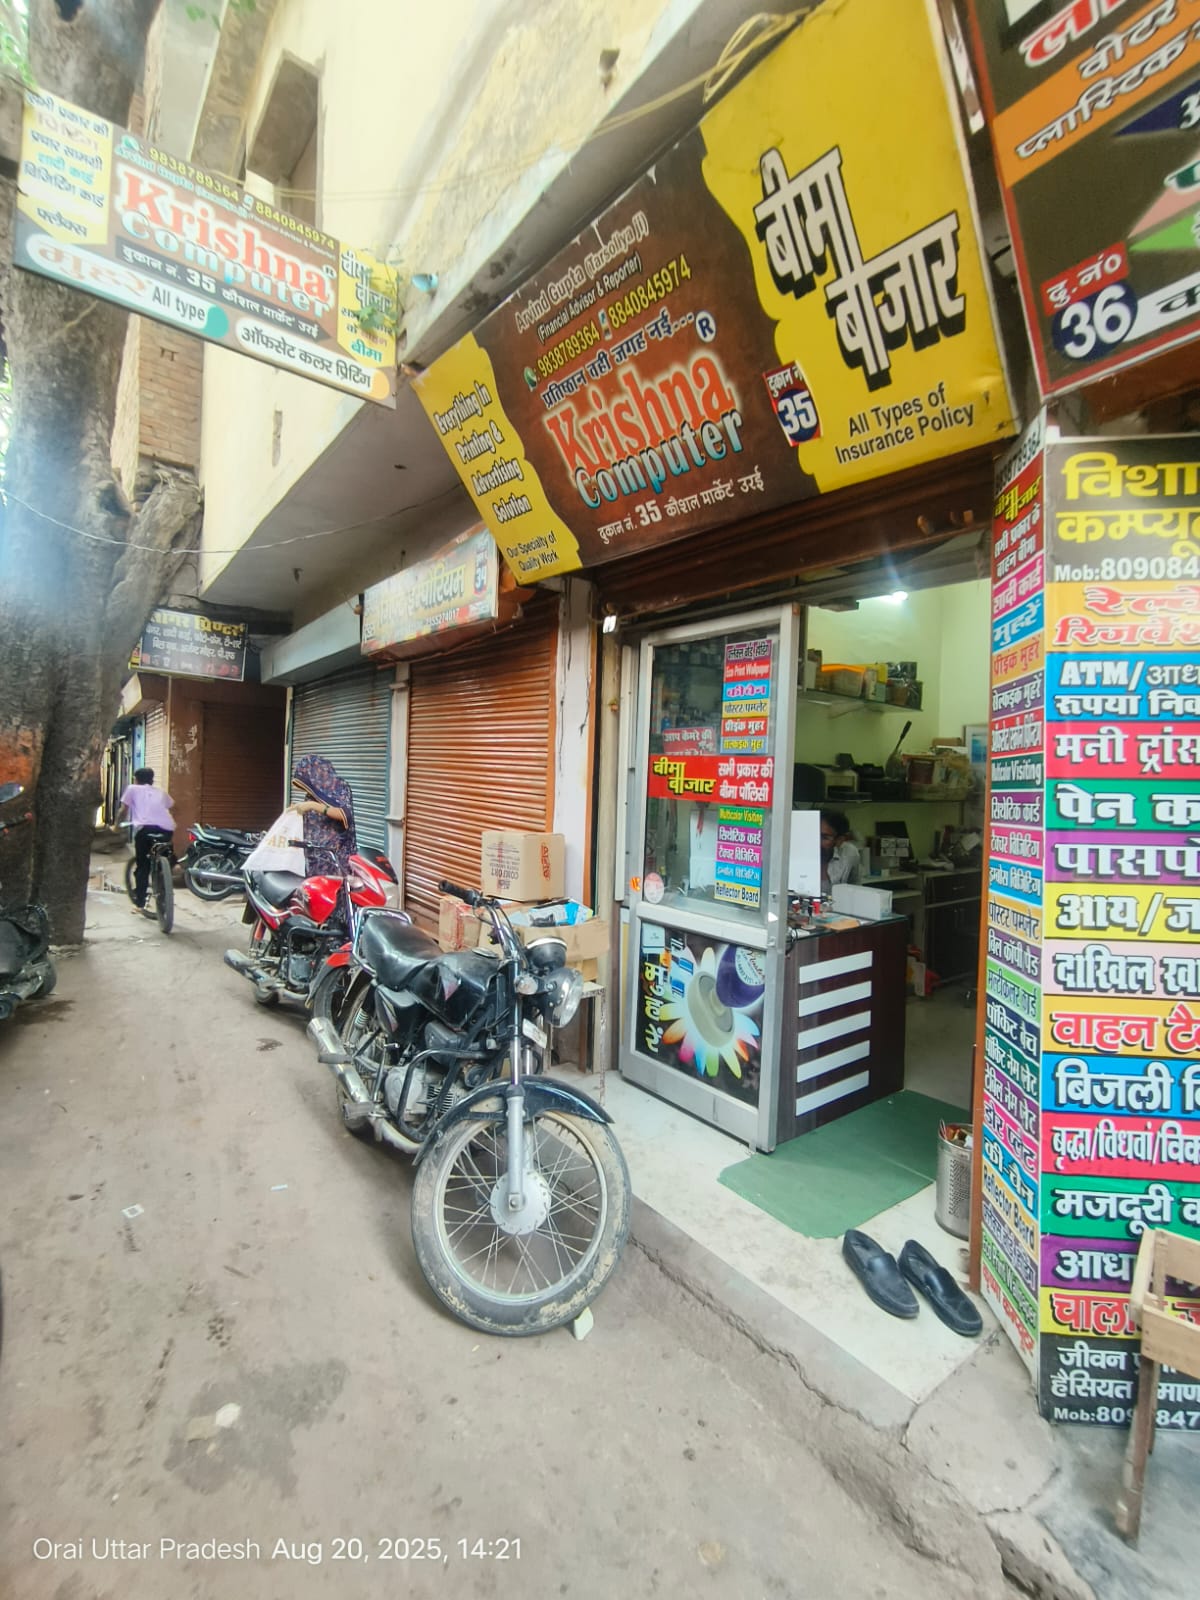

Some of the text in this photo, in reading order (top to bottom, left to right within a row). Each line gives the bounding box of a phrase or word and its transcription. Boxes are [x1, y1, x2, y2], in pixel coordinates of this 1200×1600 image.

[1015, 30, 1189, 159] प्लास्टिक
[149, 147, 335, 250] 9838789364 8840845974
[754, 146, 866, 290] बीमा
[122, 170, 331, 305] Krishna
[121, 211, 330, 318] Computer
[186, 267, 216, 294] 35
[152, 286, 205, 320] All type
[515, 302, 551, 334] Arvind
[548, 264, 587, 305] Gupta
[537, 307, 569, 344] (Financial
[568, 289, 597, 318] Advisor
[603, 252, 642, 292] Reporter)
[537, 254, 691, 377] 9838789364 8840845974
[825, 211, 966, 385] बाजार
[1061, 284, 1131, 358] 36
[241, 325, 333, 373] ऑफसेट कलर
[610, 328, 647, 363] जगह
[766, 368, 793, 398] दुकान
[434, 380, 492, 435] Everything In
[543, 353, 738, 480] Krishna
[778, 391, 818, 434] 35
[848, 382, 947, 437] All Types of
[455, 419, 505, 464] Printing &
[836, 402, 974, 466] Insurance Policy
[471, 457, 524, 496] Advertising
[574, 409, 743, 510] Computer
[492, 493, 532, 523] Solution
[597, 523, 625, 544] दुकान
[635, 500, 663, 527] 35
[737, 465, 764, 493] उरई
[549, 530, 556, 544] of
[519, 549, 559, 572] Quality Work
[993, 578, 1017, 614] शादी
[1055, 726, 1129, 764] मनी
[653, 757, 686, 780] बीमा
[718, 757, 773, 780] सभी प्रकार की
[719, 780, 737, 799] बीमा
[1011, 758, 1041, 784] Visiting
[1056, 784, 1137, 826] पेन
[741, 887, 759, 903] Board
[1055, 943, 1157, 993] दाखिल
[1052, 1012, 1160, 1051] वाहन
[1056, 1057, 1175, 1110] बिजली
[1053, 1183, 1175, 1236] मजदूरी
[1055, 1249, 1137, 1281] आध
[1057, 1340, 1127, 1370] जीवन
[1050, 1368, 1134, 1400] हैसियत
